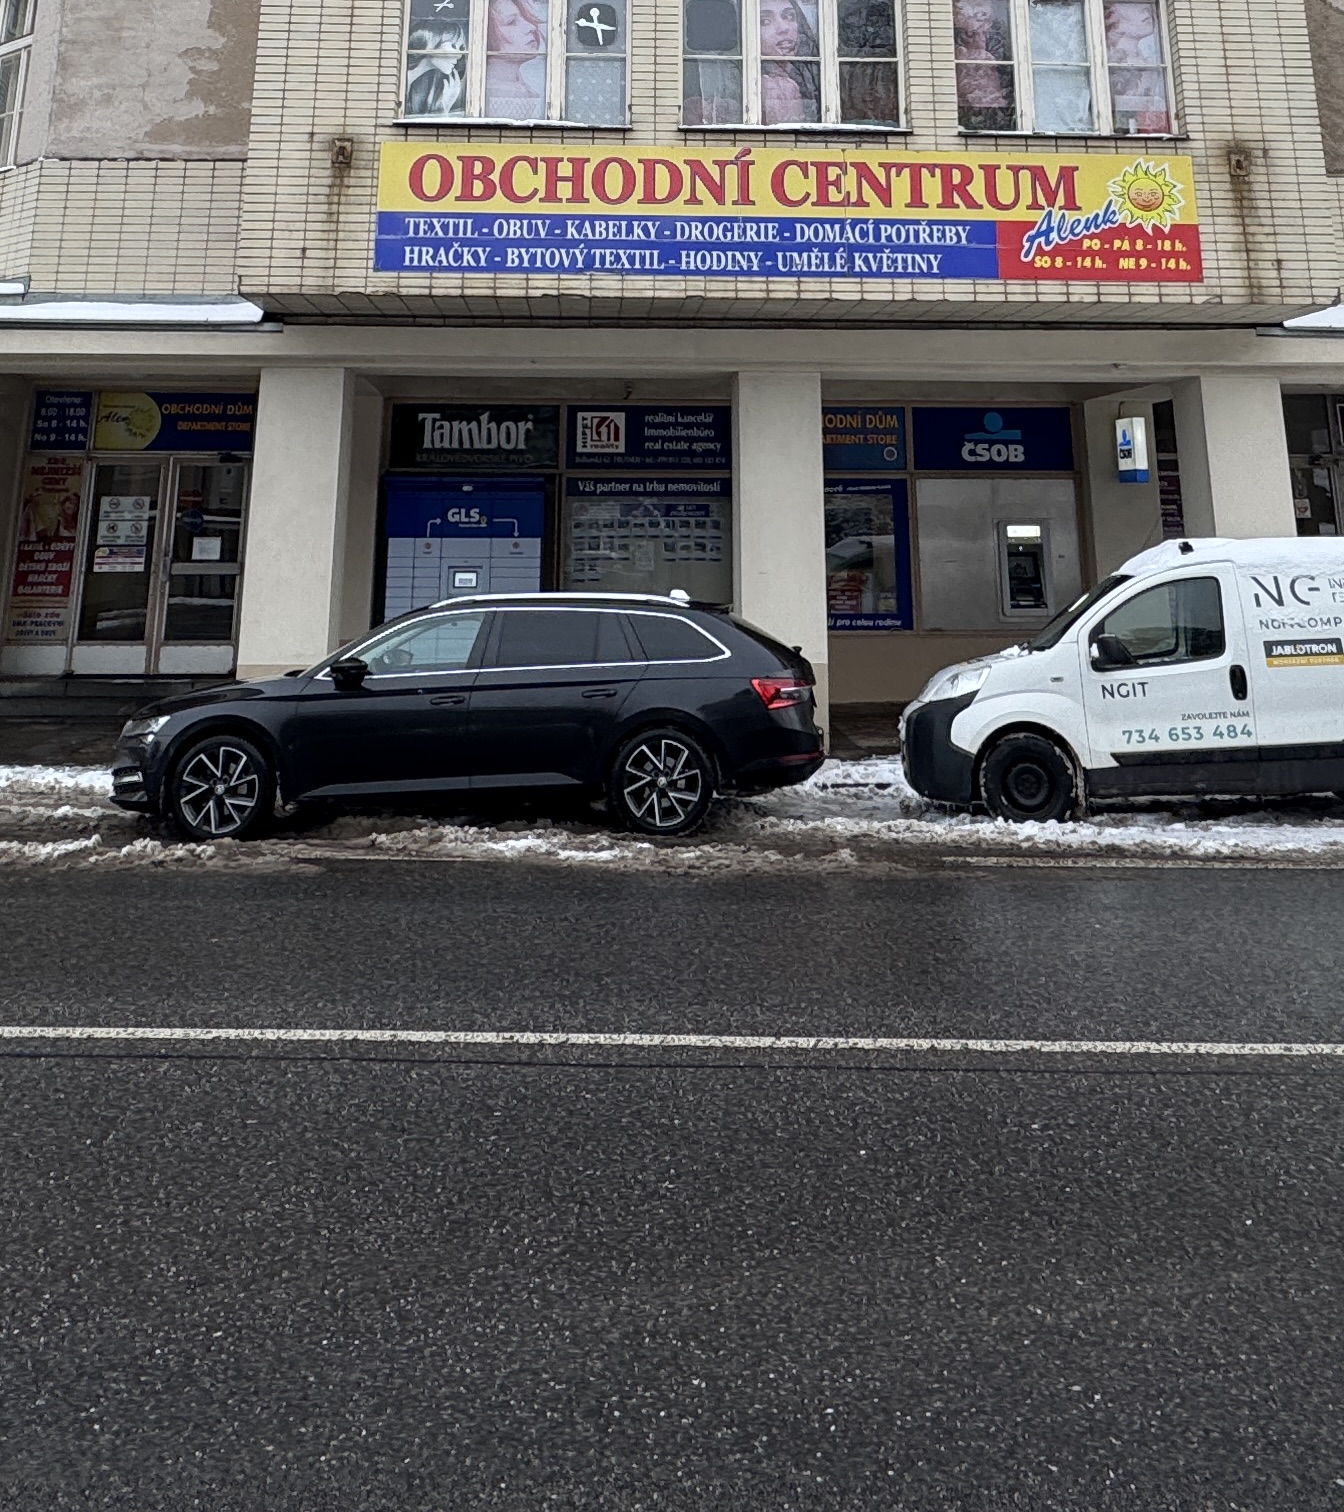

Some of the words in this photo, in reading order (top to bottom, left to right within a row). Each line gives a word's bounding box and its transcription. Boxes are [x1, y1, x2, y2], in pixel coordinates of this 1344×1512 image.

[408, 147, 756, 206] OBCHODNÍ
[771, 159, 1082, 211] CENTRUM
[404, 218, 478, 238] TEXTIL
[493, 219, 551, 239] OBUV
[566, 220, 660, 240] KABELKY
[675, 220, 779, 243] DROGERIE
[795, 221, 875, 244] DOMÁCÍ
[879, 220, 971, 245] POTŘEBY
[1082, 239, 1101, 251] PO
[1113, 236, 1130, 251] PÁ
[1135, 239, 1142, 251] 8
[1157, 239, 1172, 252] 18
[1175, 240, 1187, 252] h.
[404, 242, 492, 267] HRAČKY
[506, 243, 587, 269] BYTOVÝ
[591, 248, 665, 270] TEXTIL
[680, 250, 763, 271] HODINY
[777, 247, 850, 272] UMĚLÉ
[853, 248, 943, 273] KVĚTINY
[1034, 256, 1052, 268] SO
[1055, 256, 1063, 268] 8
[1076, 257, 1092, 269] 14
[1095, 257, 1106, 269] h.
[1119, 258, 1136, 269] NE
[1140, 258, 1147, 270] 9
[1161, 258, 1177, 270] 14
[1179, 258, 1191, 271] h.
[161, 402, 223, 415] OBCHODNÍ
[226, 401, 253, 415] DŮM
[822, 411, 862, 428] ODNÍ
[866, 410, 899, 428] DŮM
[867, 434, 898, 445] STORE
[961, 441, 1025, 463] ČSOB
[596, 482, 630, 494] partner
[633, 483, 644, 491] na
[447, 508, 480, 522] GLS
[1271, 642, 1338, 656] JABLOTRON
[1101, 681, 1149, 699] NGIT
[1181, 711, 1228, 721] ZAVOLEJTE
[1230, 709, 1250, 719] NÁM
[1122, 727, 1160, 744] 734
[1168, 726, 1204, 742] 653
[1212, 723, 1253, 739] 484
